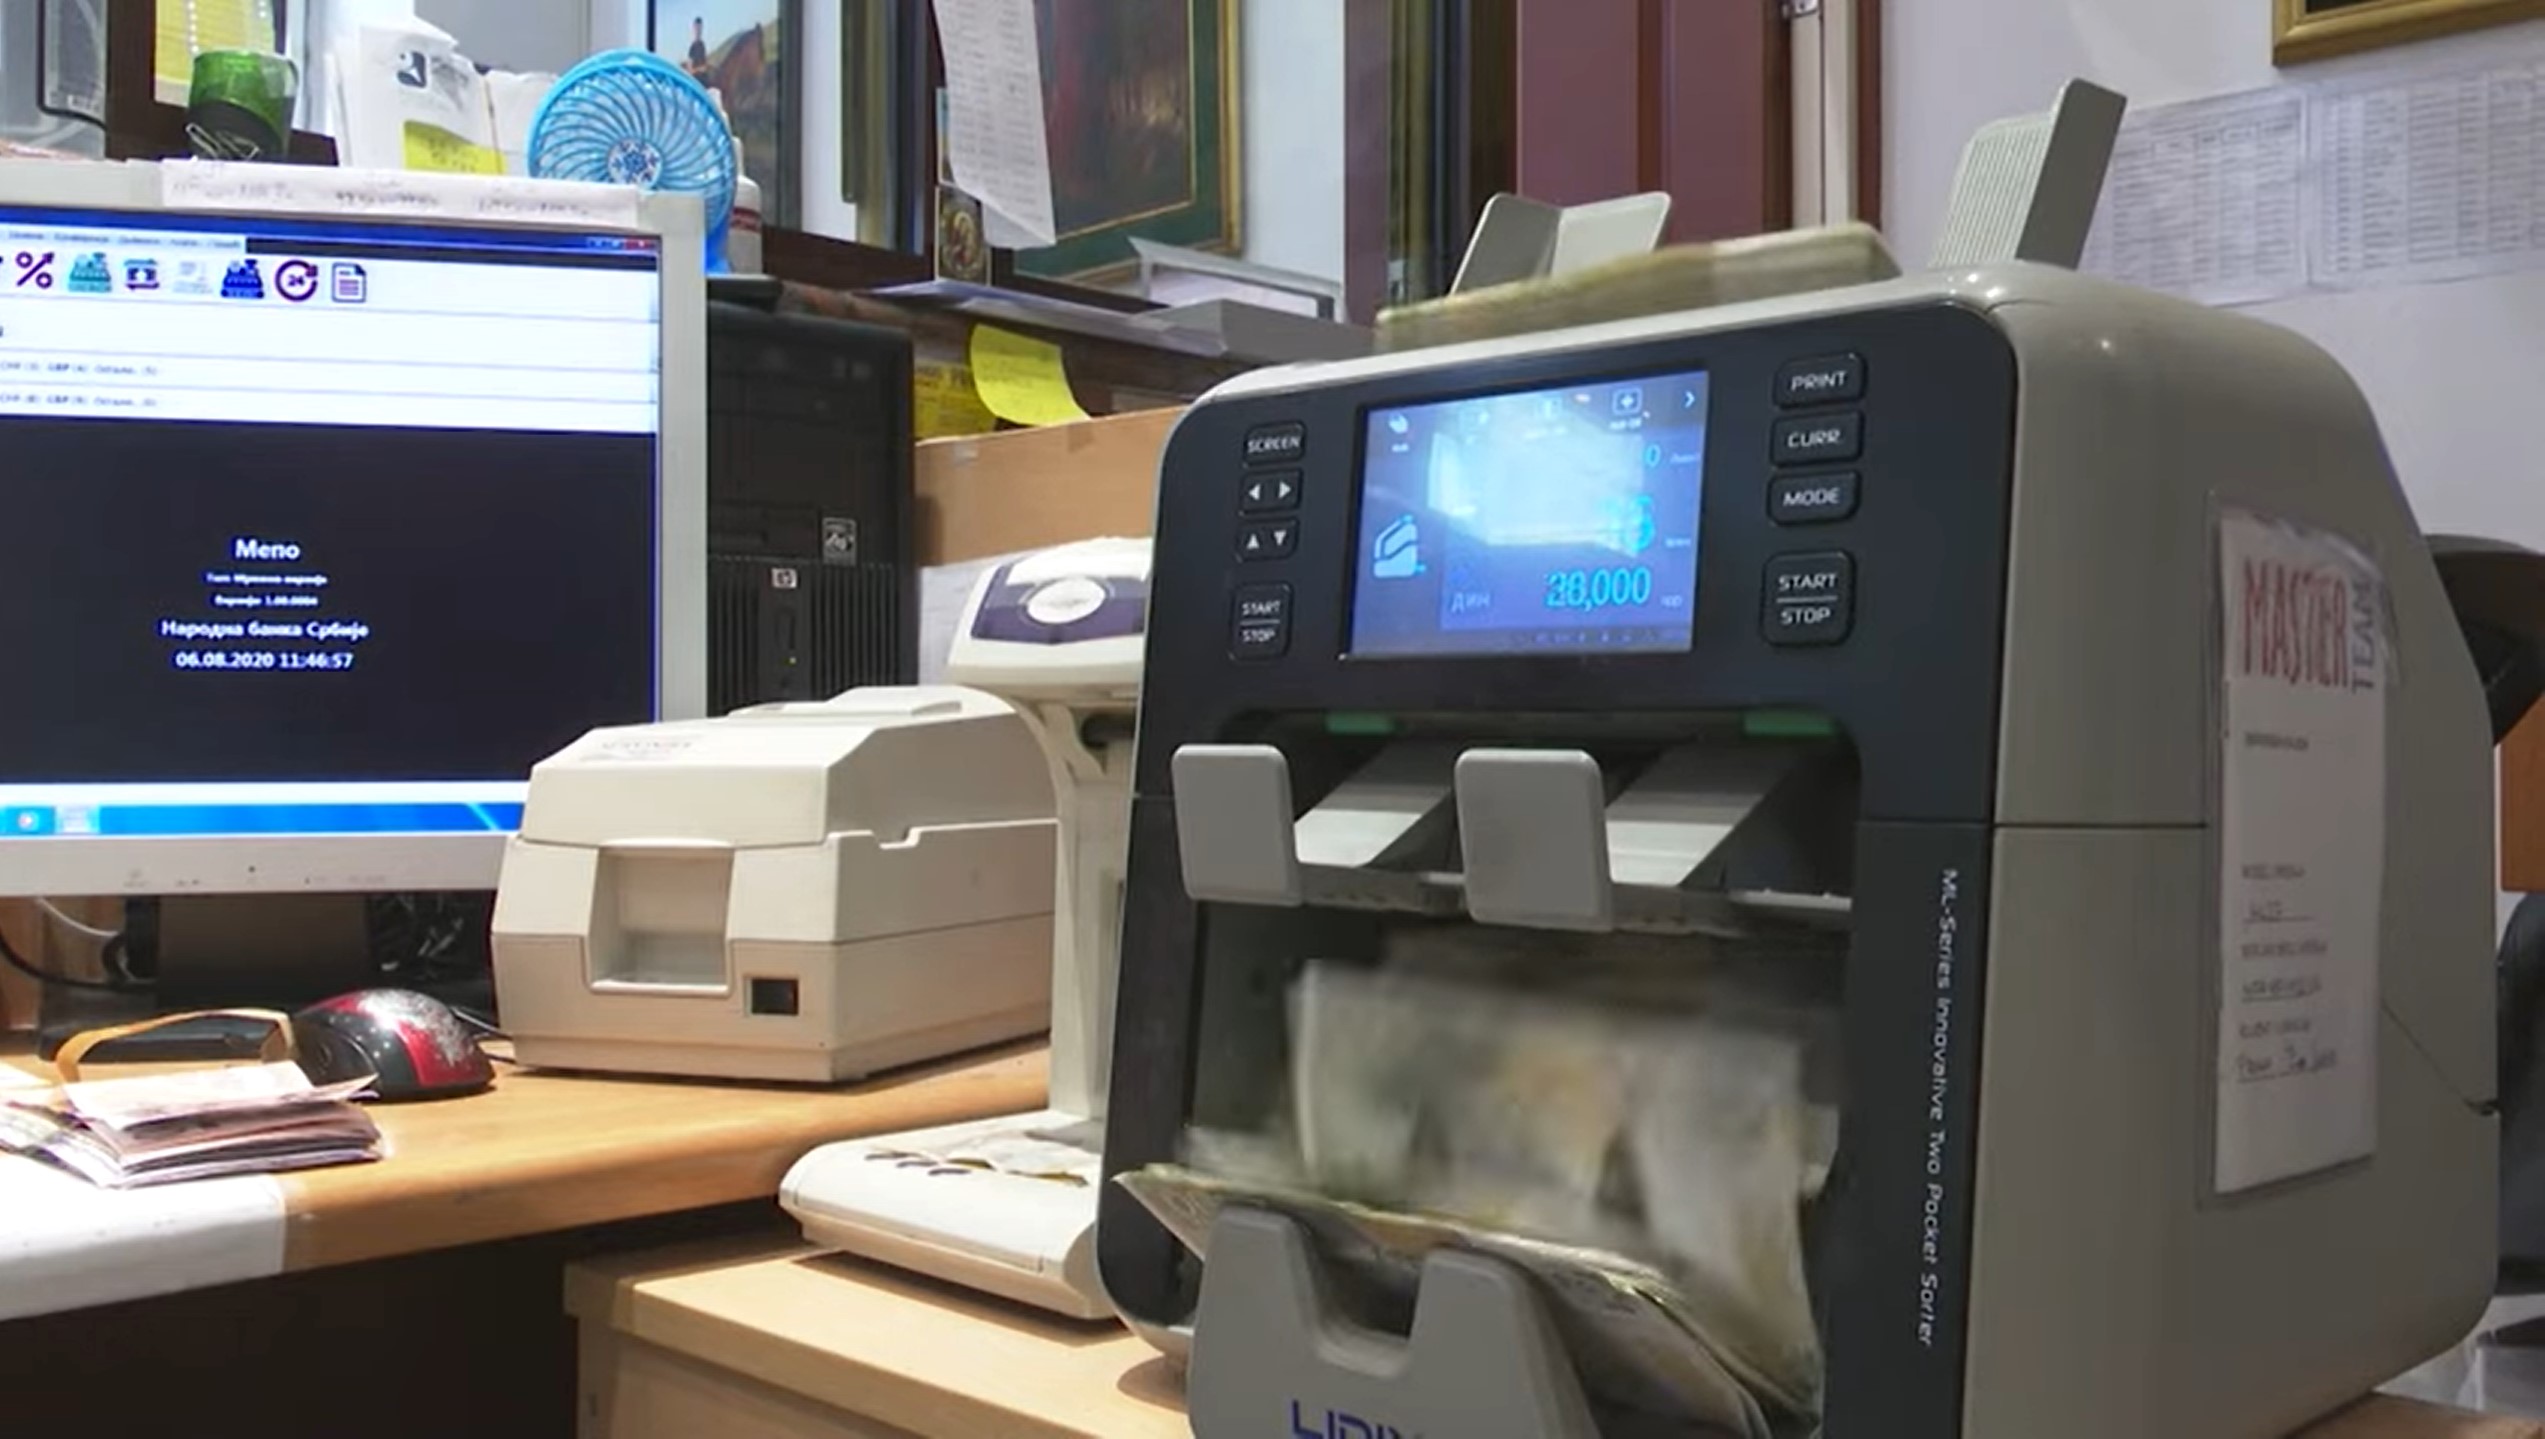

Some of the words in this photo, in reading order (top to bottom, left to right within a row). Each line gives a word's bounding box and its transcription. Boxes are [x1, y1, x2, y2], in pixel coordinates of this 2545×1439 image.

[1791, 371, 1846, 391] PRINT
[1247, 436, 1301, 453] SCREEN
[1787, 429, 1840, 448] CURR
[1783, 487, 1841, 506] MODE
[1779, 573, 1837, 592] START
[1242, 600, 1281, 616] START
[1780, 607, 1831, 625] STOP
[2244, 557, 2349, 688] MASTER
[1242, 628, 1276, 643] STOP
[2352, 574, 2374, 693] TEAM
[175, 652, 275, 668] 06.08.2020
[1937, 869, 1958, 989] ML-Series
[1930, 998, 1951, 1121] Innovative
[1927, 1130, 1946, 1175] Two
[1922, 1183, 1943, 1265] Pocket
[1918, 1274, 1938, 1347] Sorter
